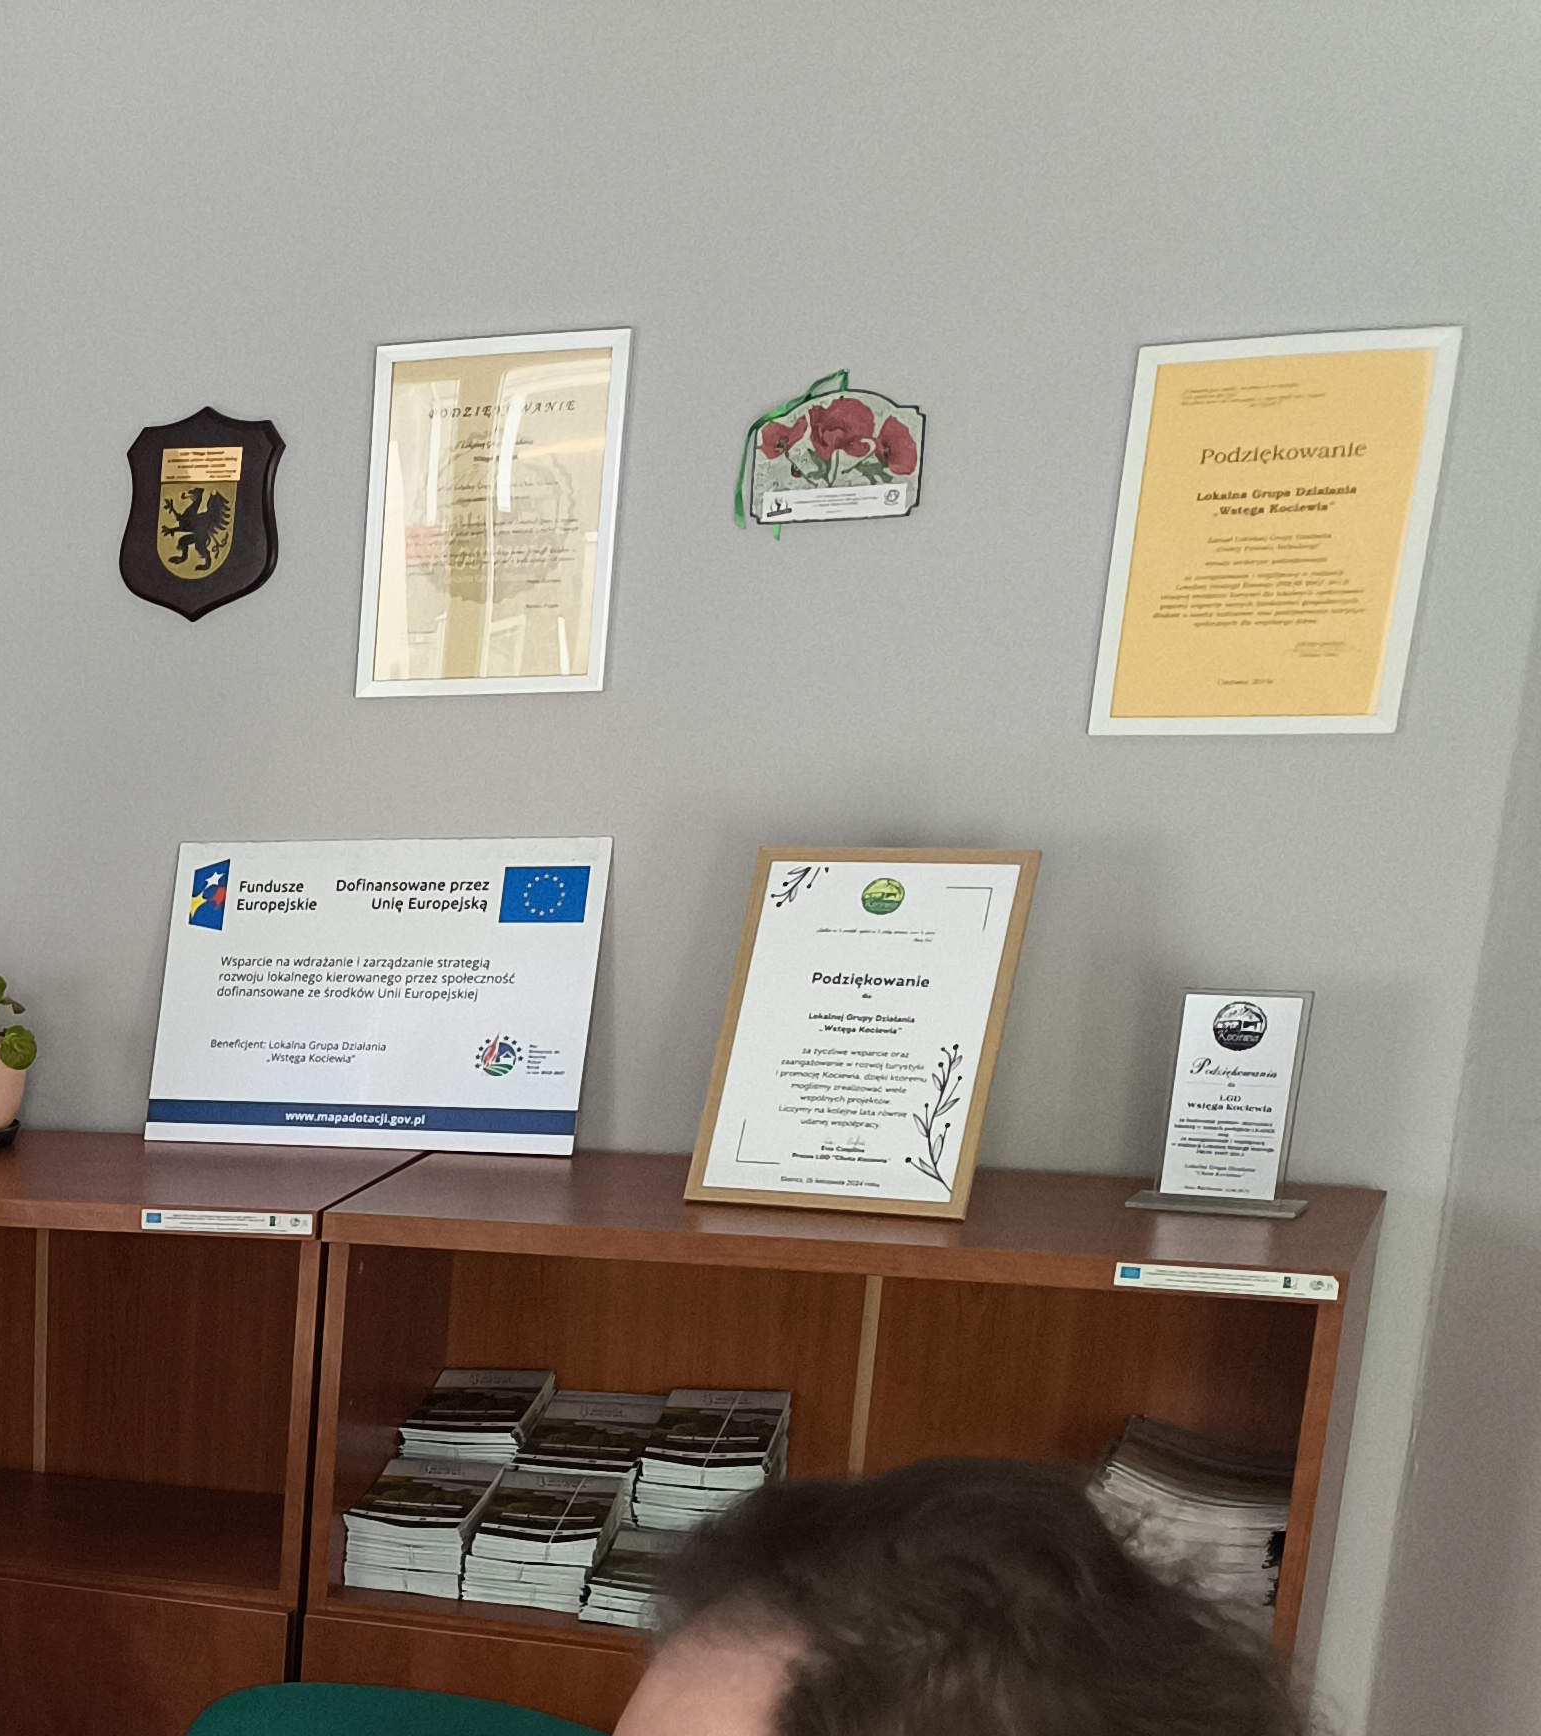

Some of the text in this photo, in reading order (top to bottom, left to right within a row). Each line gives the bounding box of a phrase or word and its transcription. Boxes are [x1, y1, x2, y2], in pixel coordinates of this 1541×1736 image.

[1200, 442, 1367, 465] Podziękowanie
[239, 880, 304, 893] Fundusze
[336, 878, 489, 894] Dofinansowane przez
[237, 897, 317, 913] Europejskie
[372, 896, 487, 913] Unię Europejską
[221, 956, 272, 969] Wsparcie
[294, 956, 353, 967] wdrażanie
[363, 957, 433, 970] zarządzanie
[437, 958, 490, 971] strategią
[219, 970, 515, 986] rozwoju lokalnego kierowanego przez społeczność
[811, 972, 929, 988] Podziękowanie
[217, 986, 478, 1002] dofinansowane ze środków Unii Europejskiej
